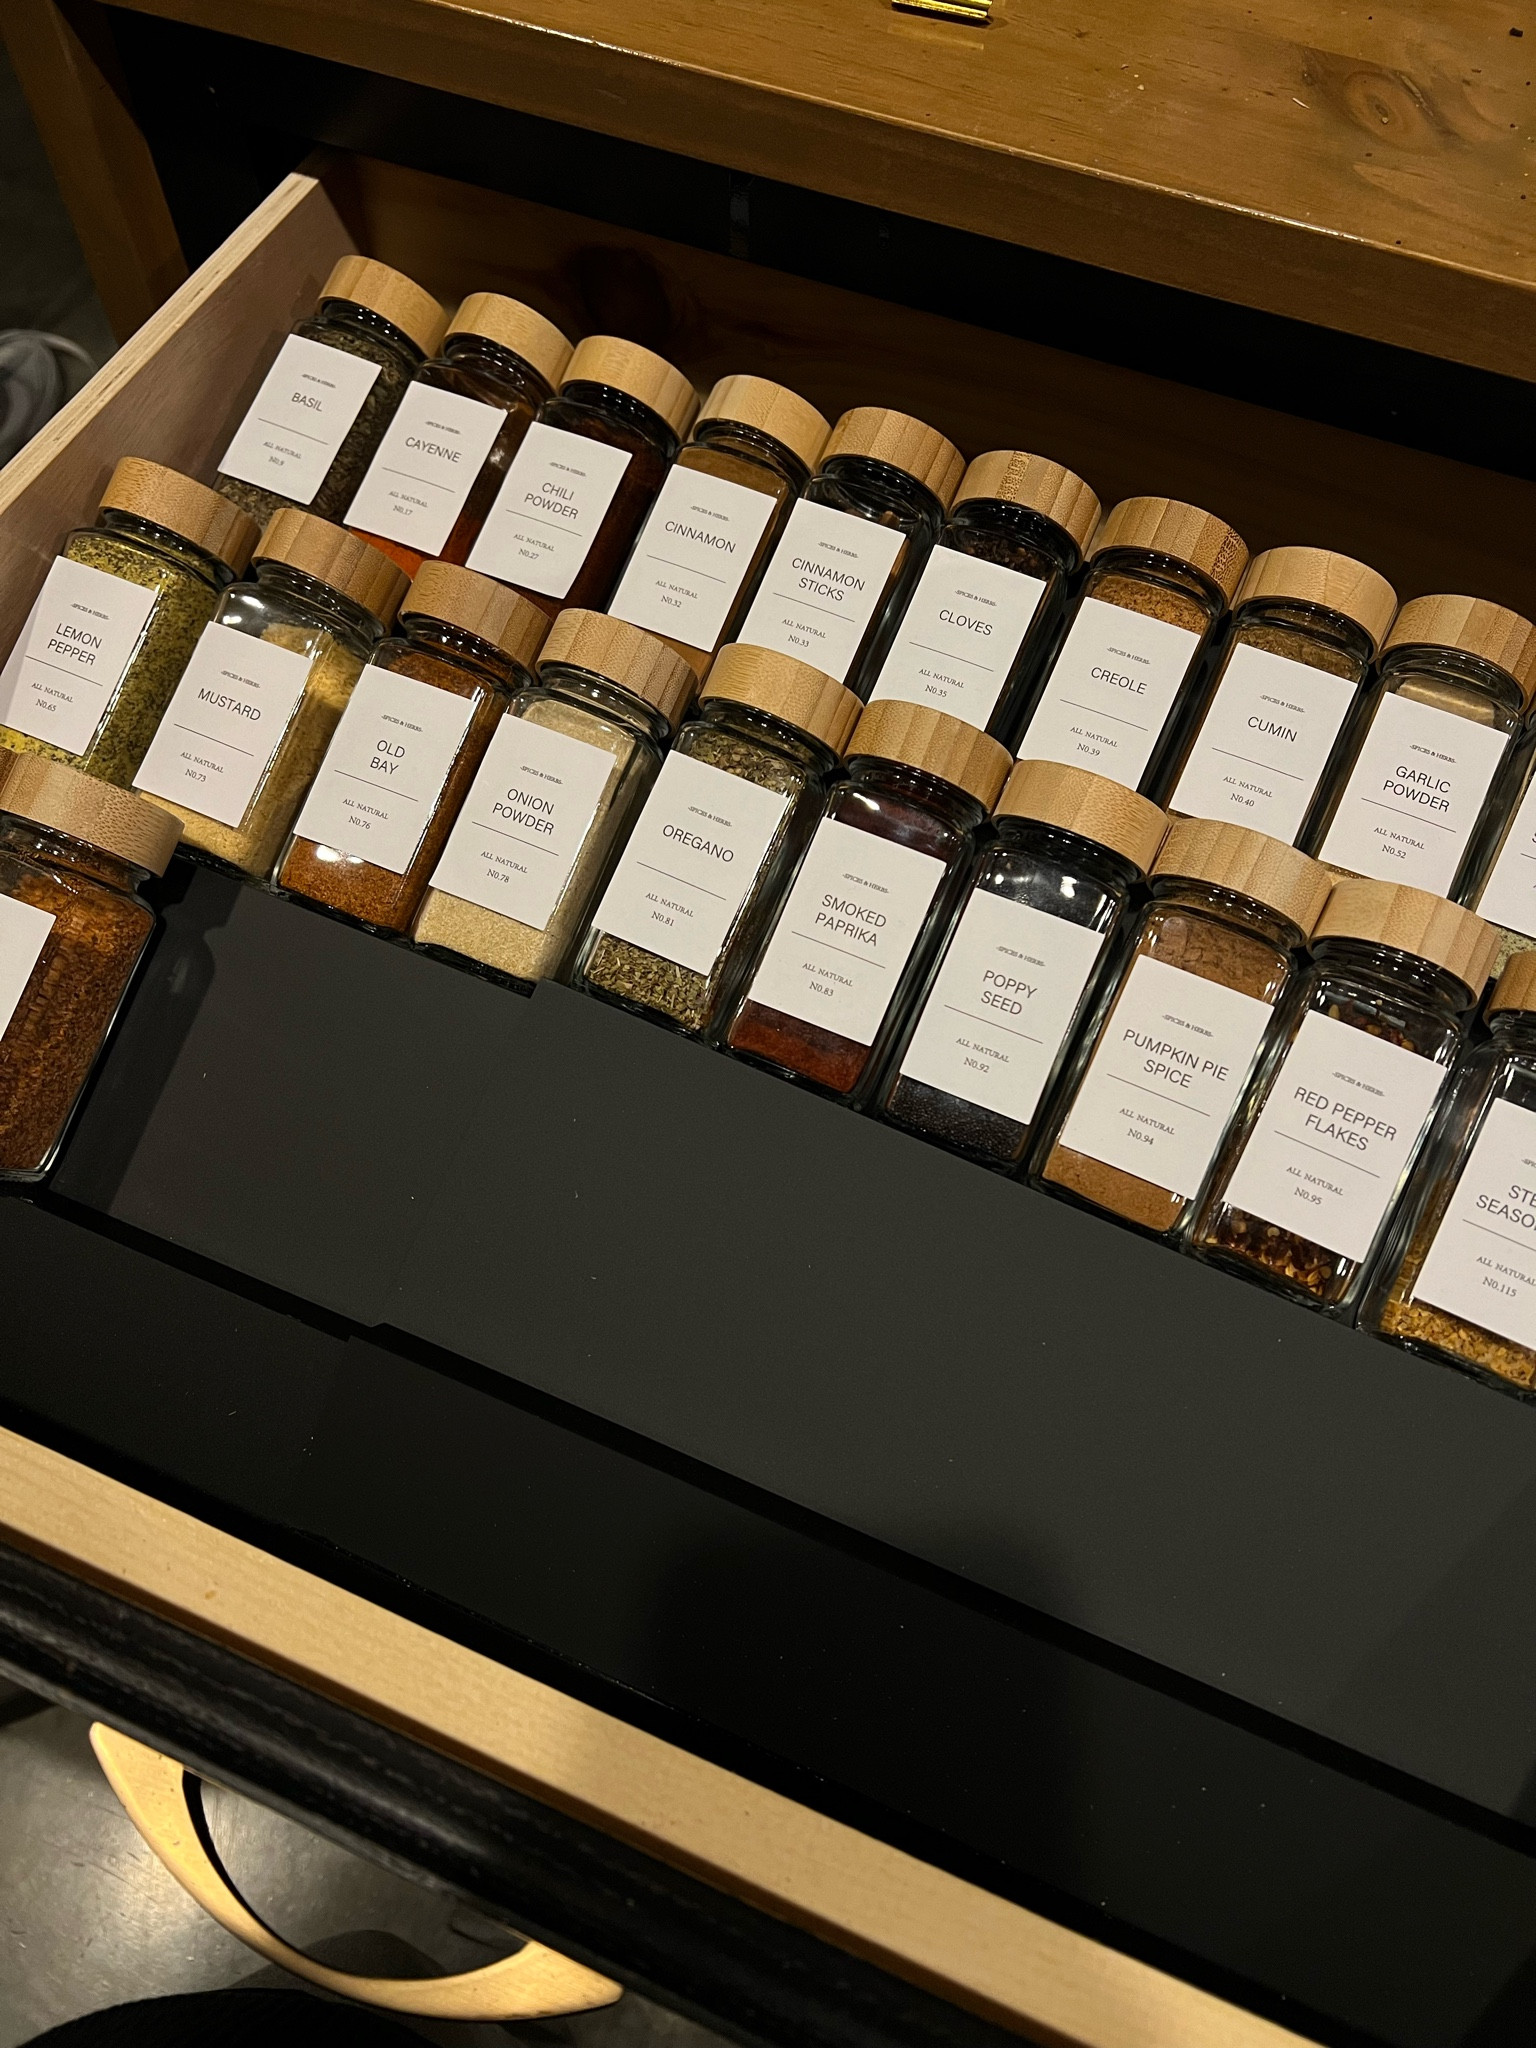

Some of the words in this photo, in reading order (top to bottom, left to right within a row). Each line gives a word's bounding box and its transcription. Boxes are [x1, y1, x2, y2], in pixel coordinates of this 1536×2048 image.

[291, 392, 322, 412] BASIL
[405, 437, 462, 463] CAYENNE
[542, 483, 574, 501] CHILI
[524, 493, 578, 520] POWDER
[525, 537, 554, 552] NATURAL
[665, 521, 736, 553] CINNAMON
[792, 558, 865, 591] CINNAMON
[655, 580, 666, 588] ALL
[668, 584, 698, 599] NATURAL
[799, 577, 844, 601] STICKS
[781, 619, 794, 627] ALL
[795, 623, 826, 639] NATURAL
[939, 609, 993, 636] CLOVES
[56, 623, 103, 649] LEMON
[47, 639, 96, 666] PEPPER
[918, 668, 931, 677] ALL
[932, 673, 964, 688] NATURAL
[1091, 667, 1147, 695] CREOLE
[31, 682, 43, 691] ALL
[44, 686, 73, 703] NATURAL
[198, 688, 261, 720] MUSTARD
[1070, 727, 1083, 735] ALL
[1084, 731, 1117, 747] NATURAL
[1248, 716, 1297, 742] CUMIN
[377, 740, 405, 758] OLD
[180, 752, 192, 760] ALL
[193, 756, 223, 773] NATURAL
[370, 756, 399, 775] BAY
[1223, 776, 1237, 785] ALL
[1238, 781, 1272, 798] NATURAL
[1396, 765, 1451, 793] GARLIC
[342, 799, 355, 807] ALL
[356, 803, 388, 820] NATURAL
[507, 789, 554, 815] ONION
[1383, 780, 1450, 813] POWDER
[492, 802, 554, 836] POWDER
[663, 825, 734, 862] OREGANO
[1374, 827, 1388, 837] ALL
[1389, 832, 1424, 850] NATURAL
[480, 851, 493, 860] ALL
[495, 856, 527, 873] NATURAL
[645, 892, 659, 902] ALL
[660, 898, 693, 917] NATURAL
[822, 894, 887, 927] SMOKED
[815, 912, 877, 947] PAPRIKA
[802, 963, 816, 972] ALL
[817, 968, 853, 987] NATURAL
[983, 970, 1038, 999] POPPY
[981, 990, 1022, 1015] SEED
[956, 1038, 971, 1048] ALL
[972, 1043, 1009, 1063] NATURAL
[1123, 1029, 1200, 1069] PUMPKIN
[1201, 1060, 1229, 1081] PIE
[1143, 1059, 1193, 1088] SPICE
[1119, 1108, 1134, 1118] ALL
[1136, 1114, 1175, 1135] NATURAL
[1294, 1086, 1329, 1110] RED
[1331, 1102, 1397, 1141] PEPPER
[1305, 1113, 1369, 1151] FLAKES
[1286, 1166, 1302, 1177] ALL
[1304, 1173, 1343, 1196] NATURAL
[1476, 1195, 1536, 1231] SEASO
[1476, 1256, 1493, 1267] ALL
